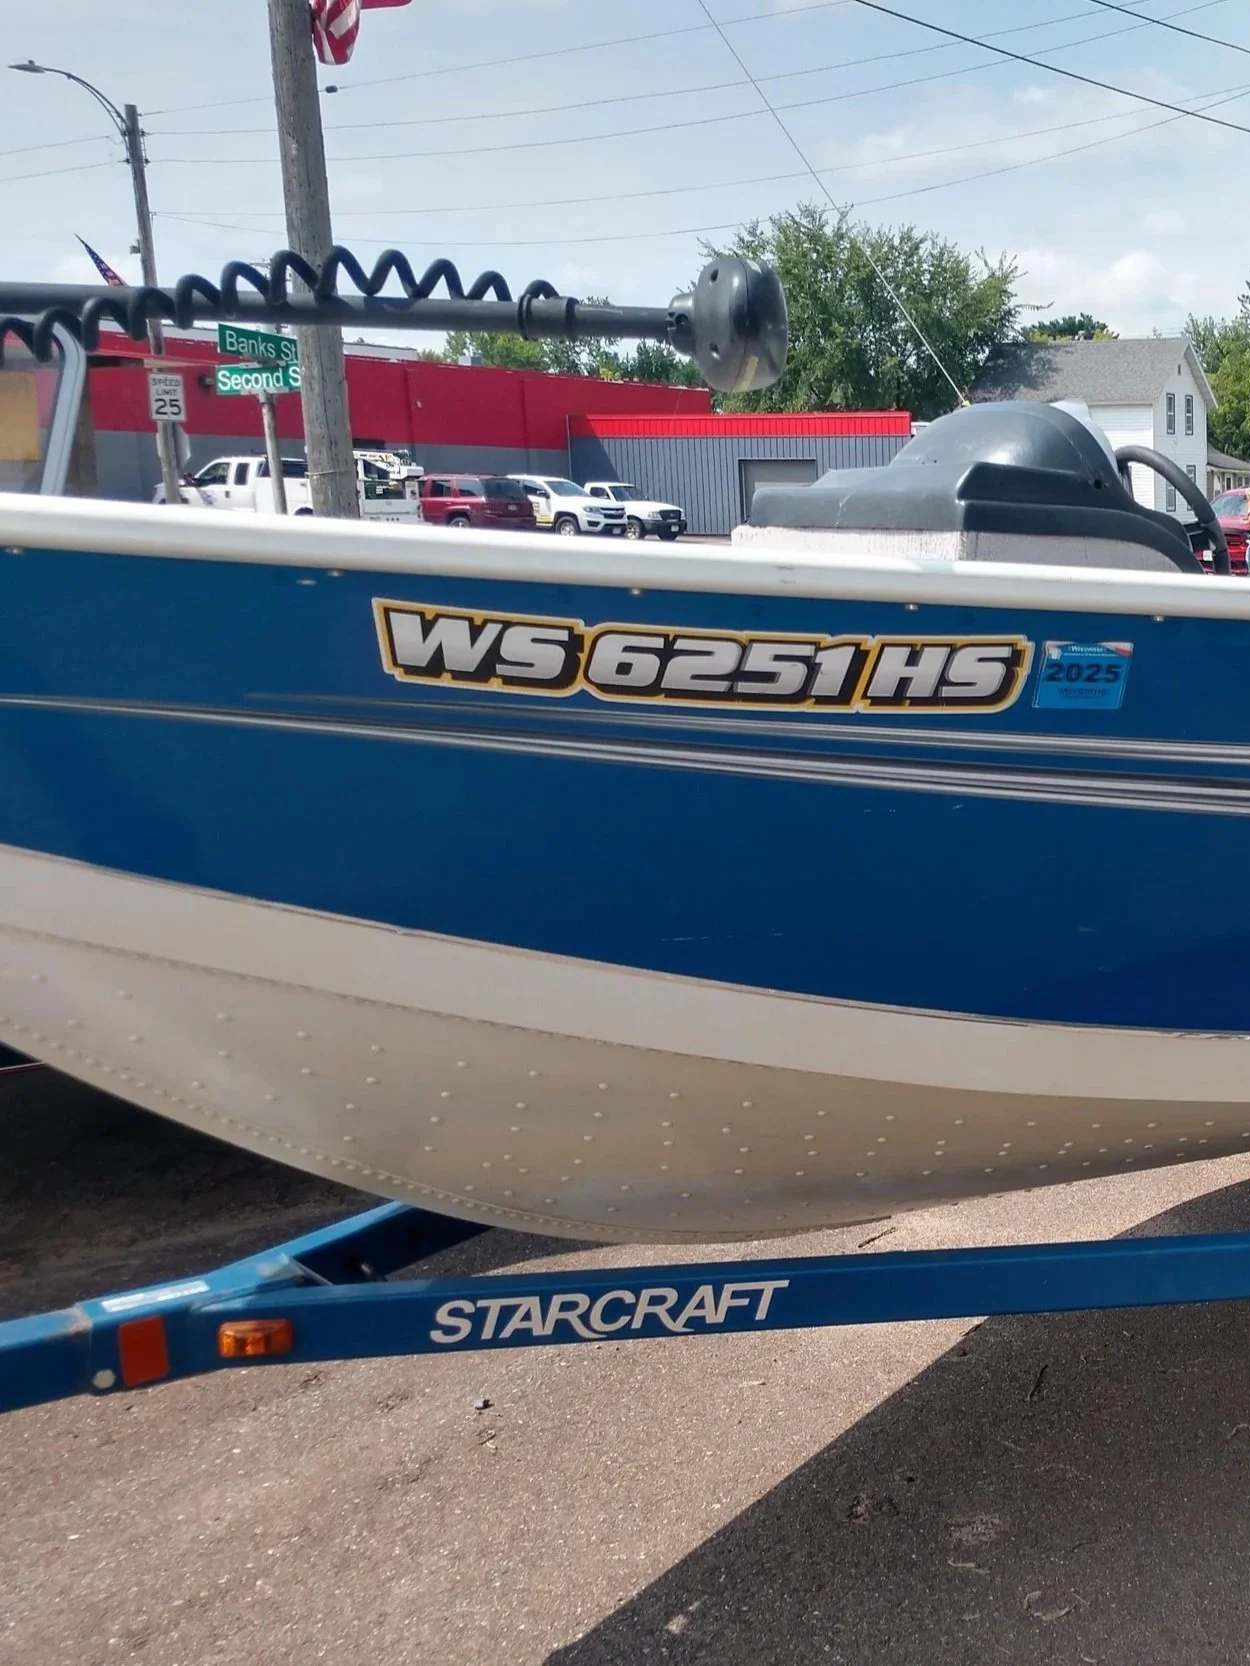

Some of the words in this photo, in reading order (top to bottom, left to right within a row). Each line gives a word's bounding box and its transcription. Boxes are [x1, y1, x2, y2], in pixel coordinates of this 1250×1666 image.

[225, 329, 276, 359] Banks
[280, 341, 297, 362] St
[151, 377, 181, 387] SPEED
[217, 367, 283, 391] Second
[288, 366, 302, 387] S
[154, 398, 182, 416] 25
[386, 609, 582, 685] WS
[586, 632, 858, 699] 6251
[865, 643, 1016, 699] HS
[1044, 662, 1121, 683] 2025
[429, 1279, 790, 1344] STARCRAFT
